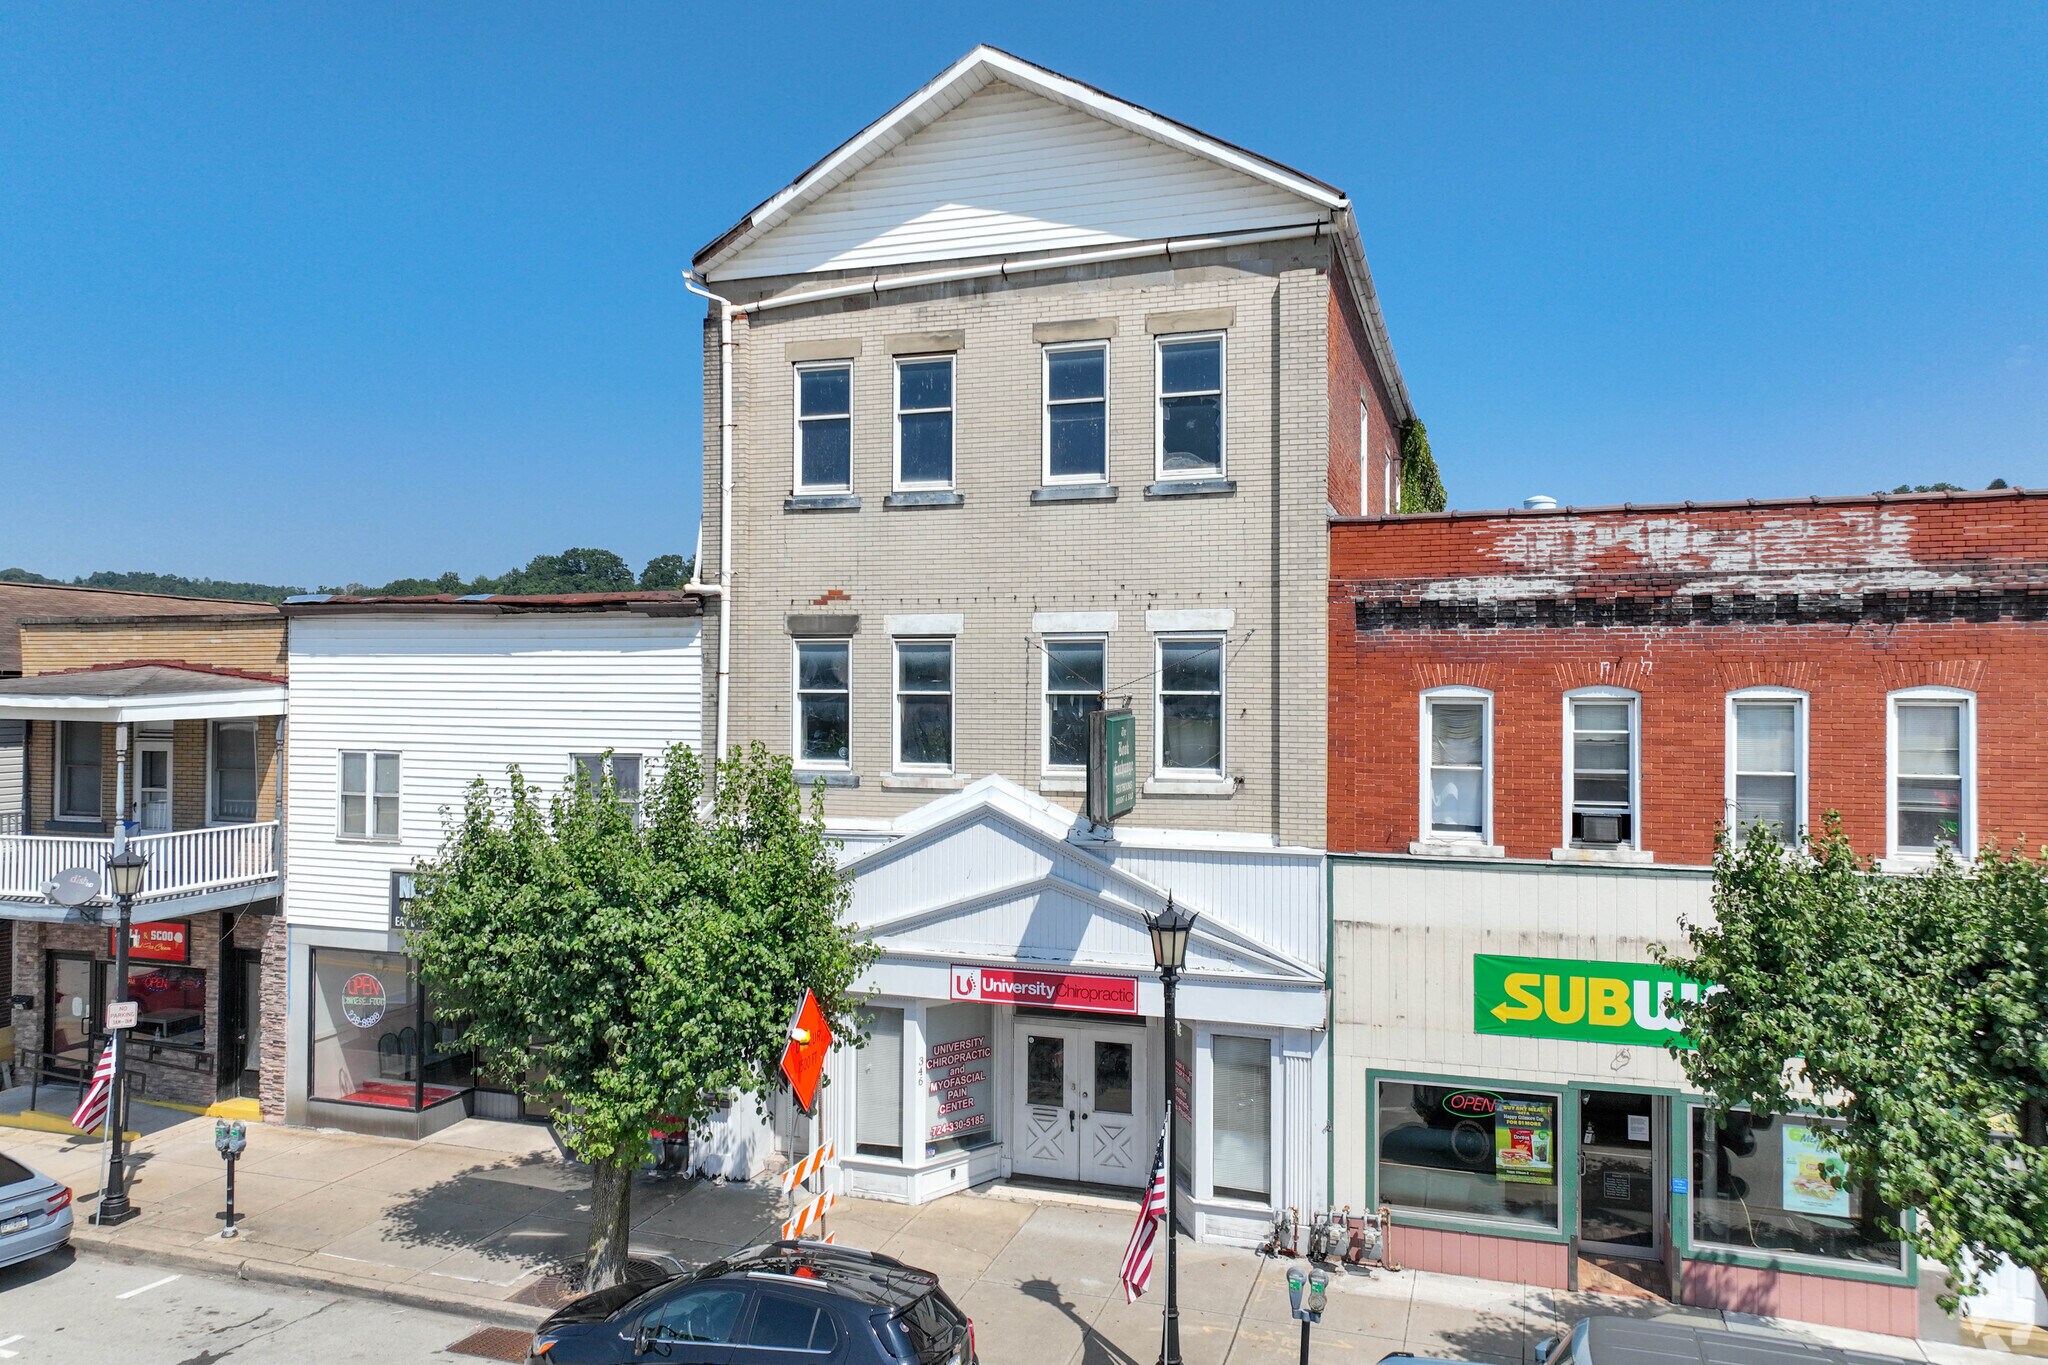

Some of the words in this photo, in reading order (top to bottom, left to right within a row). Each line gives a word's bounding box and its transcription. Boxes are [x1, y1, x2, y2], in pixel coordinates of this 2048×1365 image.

[1118, 741, 1130, 757] Book
[1114, 760, 1134, 777] Exchange
[70, 875, 89, 885] dish
[145, 977, 170, 989] OPEN
[347, 976, 380, 996] OPEN
[982, 978, 1055, 999] University
[1056, 982, 1134, 1003] Chiropractic
[933, 1036, 985, 1056] UNIVERSITY
[926, 1048, 991, 1069] CHIROPRACTIC
[949, 1065, 965, 1076] and
[930, 1072, 986, 1092] MYOFASCIAL
[948, 1088, 967, 1100] PAIN
[939, 1097, 974, 1115] CENTER
[1451, 1094, 1496, 1113] OPEN
[932, 1115, 985, 1137] 724-330-5185
